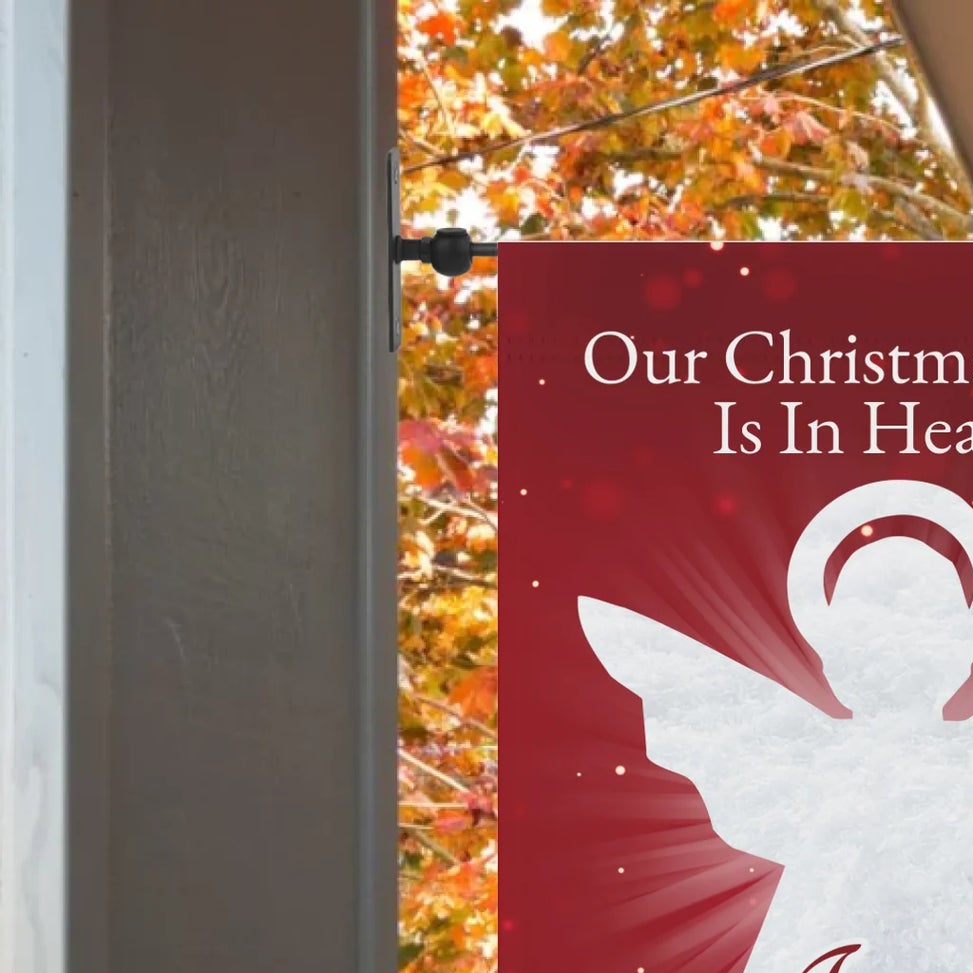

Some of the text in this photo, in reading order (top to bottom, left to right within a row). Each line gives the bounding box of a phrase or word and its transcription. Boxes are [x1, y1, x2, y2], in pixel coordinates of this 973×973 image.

[583, 330, 708, 385] Our
[713, 401, 762, 454] Is
[779, 401, 845, 454] In
